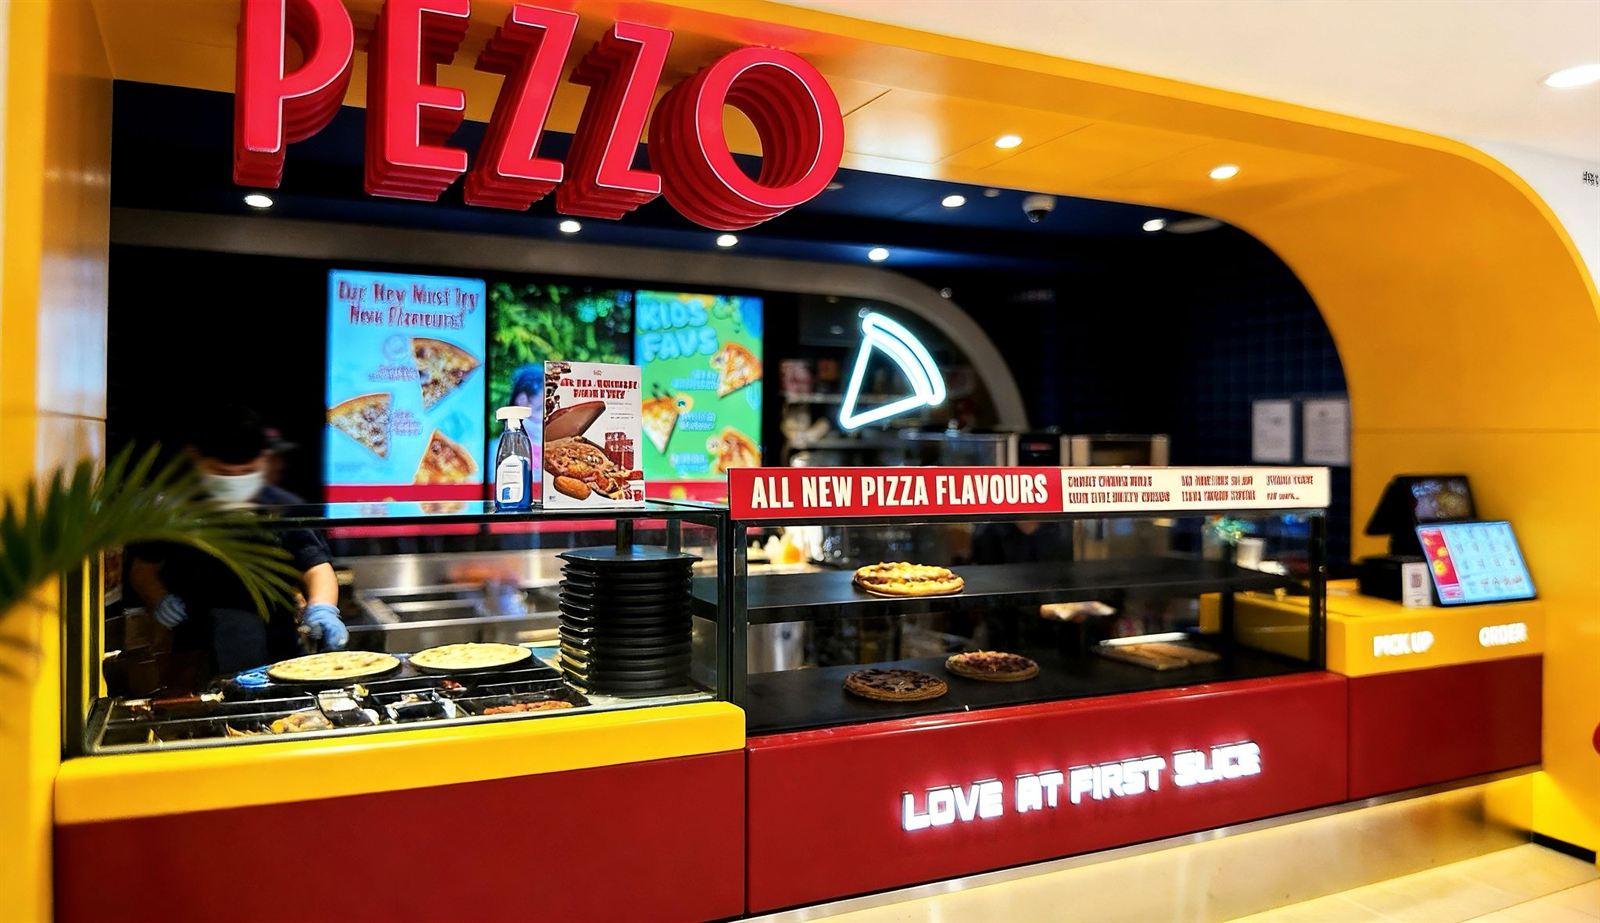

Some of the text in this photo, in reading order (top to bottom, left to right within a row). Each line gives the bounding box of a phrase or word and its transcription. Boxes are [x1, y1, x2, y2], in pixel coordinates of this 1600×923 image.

[234, 0, 844, 229] PEZZO
[636, 299, 708, 331] KIDS
[641, 326, 719, 362] FAVS
[751, 476, 794, 508] ALL
[802, 475, 852, 508] NEW
[861, 475, 929, 507] PIZZA
[936, 473, 1049, 505] FLAVOURS
[1373, 630, 1435, 657] PICK UP
[1479, 622, 1529, 648] ORDER
[902, 740, 1262, 832] LOVE AT FIRST SLICE
